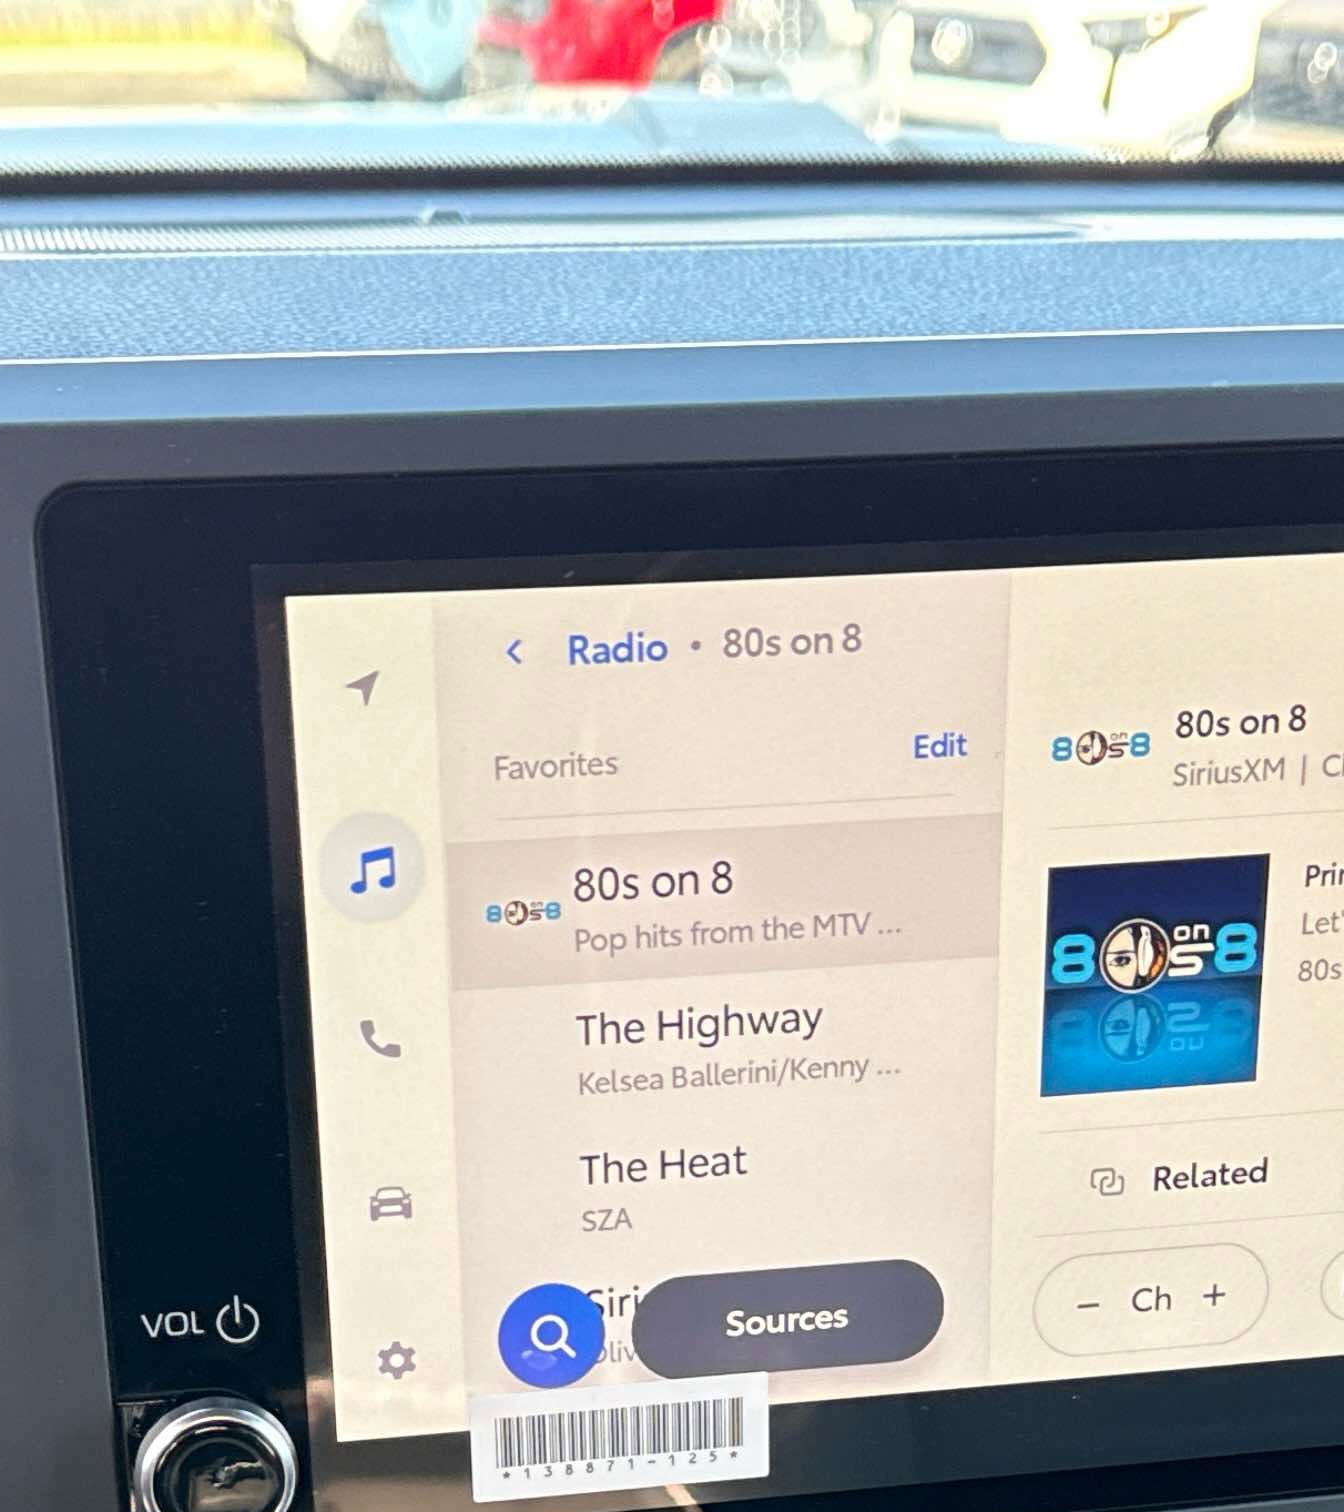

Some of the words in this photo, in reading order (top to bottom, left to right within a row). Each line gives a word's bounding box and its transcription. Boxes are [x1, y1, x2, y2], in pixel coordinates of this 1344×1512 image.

[567, 630, 669, 668] Radio
[722, 626, 783, 658] 80s
[790, 628, 835, 656] on
[841, 623, 863, 653] 8
[1176, 710, 1230, 740] 80s
[1239, 711, 1280, 736] on
[1288, 705, 1308, 732] 8
[912, 732, 969, 760] Edit
[493, 751, 619, 781] Favorites
[1173, 758, 1286, 788] SiriusXM
[574, 865, 640, 903] 80s
[651, 866, 700, 899] on
[711, 860, 734, 895] 8
[575, 928, 626, 957] Pop
[635, 921, 682, 949] hits
[691, 919, 754, 946] from
[762, 914, 805, 941] the
[812, 911, 871, 938] MTV
[1173, 924, 1209, 942] on
[1214, 923, 1258, 973] 8
[1298, 956, 1342, 982] 80s
[576, 1012, 645, 1046] The
[657, 1004, 823, 1048] Highway
[578, 1067, 664, 1096] Kelsea
[671, 1055, 870, 1089] Ballerini/Kenny
[580, 1152, 648, 1186] The
[659, 1145, 748, 1180] Heat
[1153, 1157, 1269, 1193] Related
[582, 1206, 633, 1233] SZA
[1131, 1285, 1172, 1313] Ch
[140, 1311, 205, 1338] VOL
[726, 1305, 849, 1338] Sources
